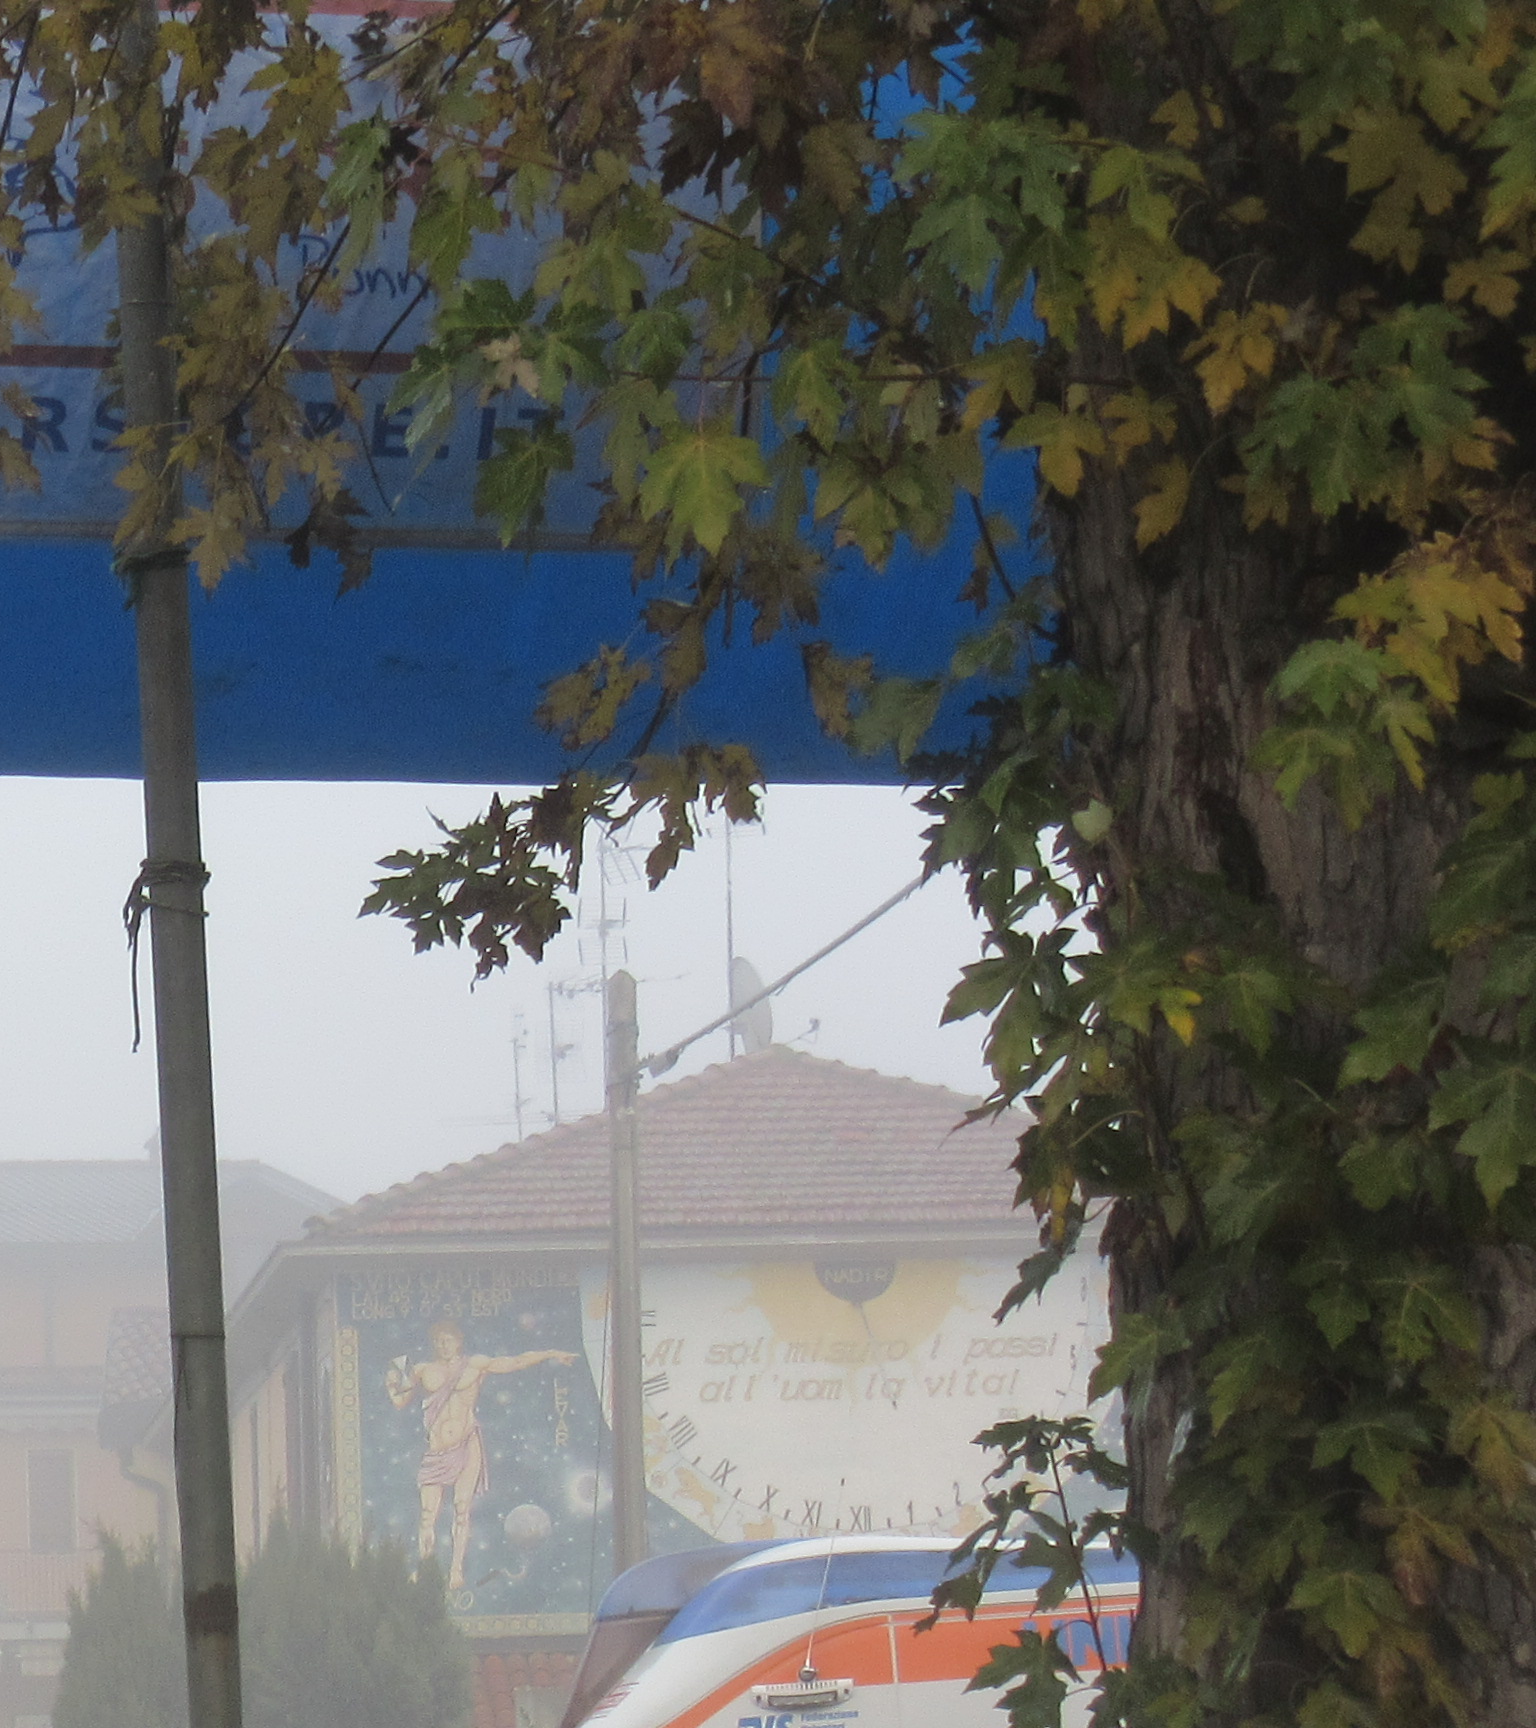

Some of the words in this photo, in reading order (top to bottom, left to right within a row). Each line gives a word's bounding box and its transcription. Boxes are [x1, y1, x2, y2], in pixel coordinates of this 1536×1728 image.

[704, 1337, 766, 1367] sol
[962, 1332, 1058, 1365] passi
[864, 1372, 906, 1400] la
